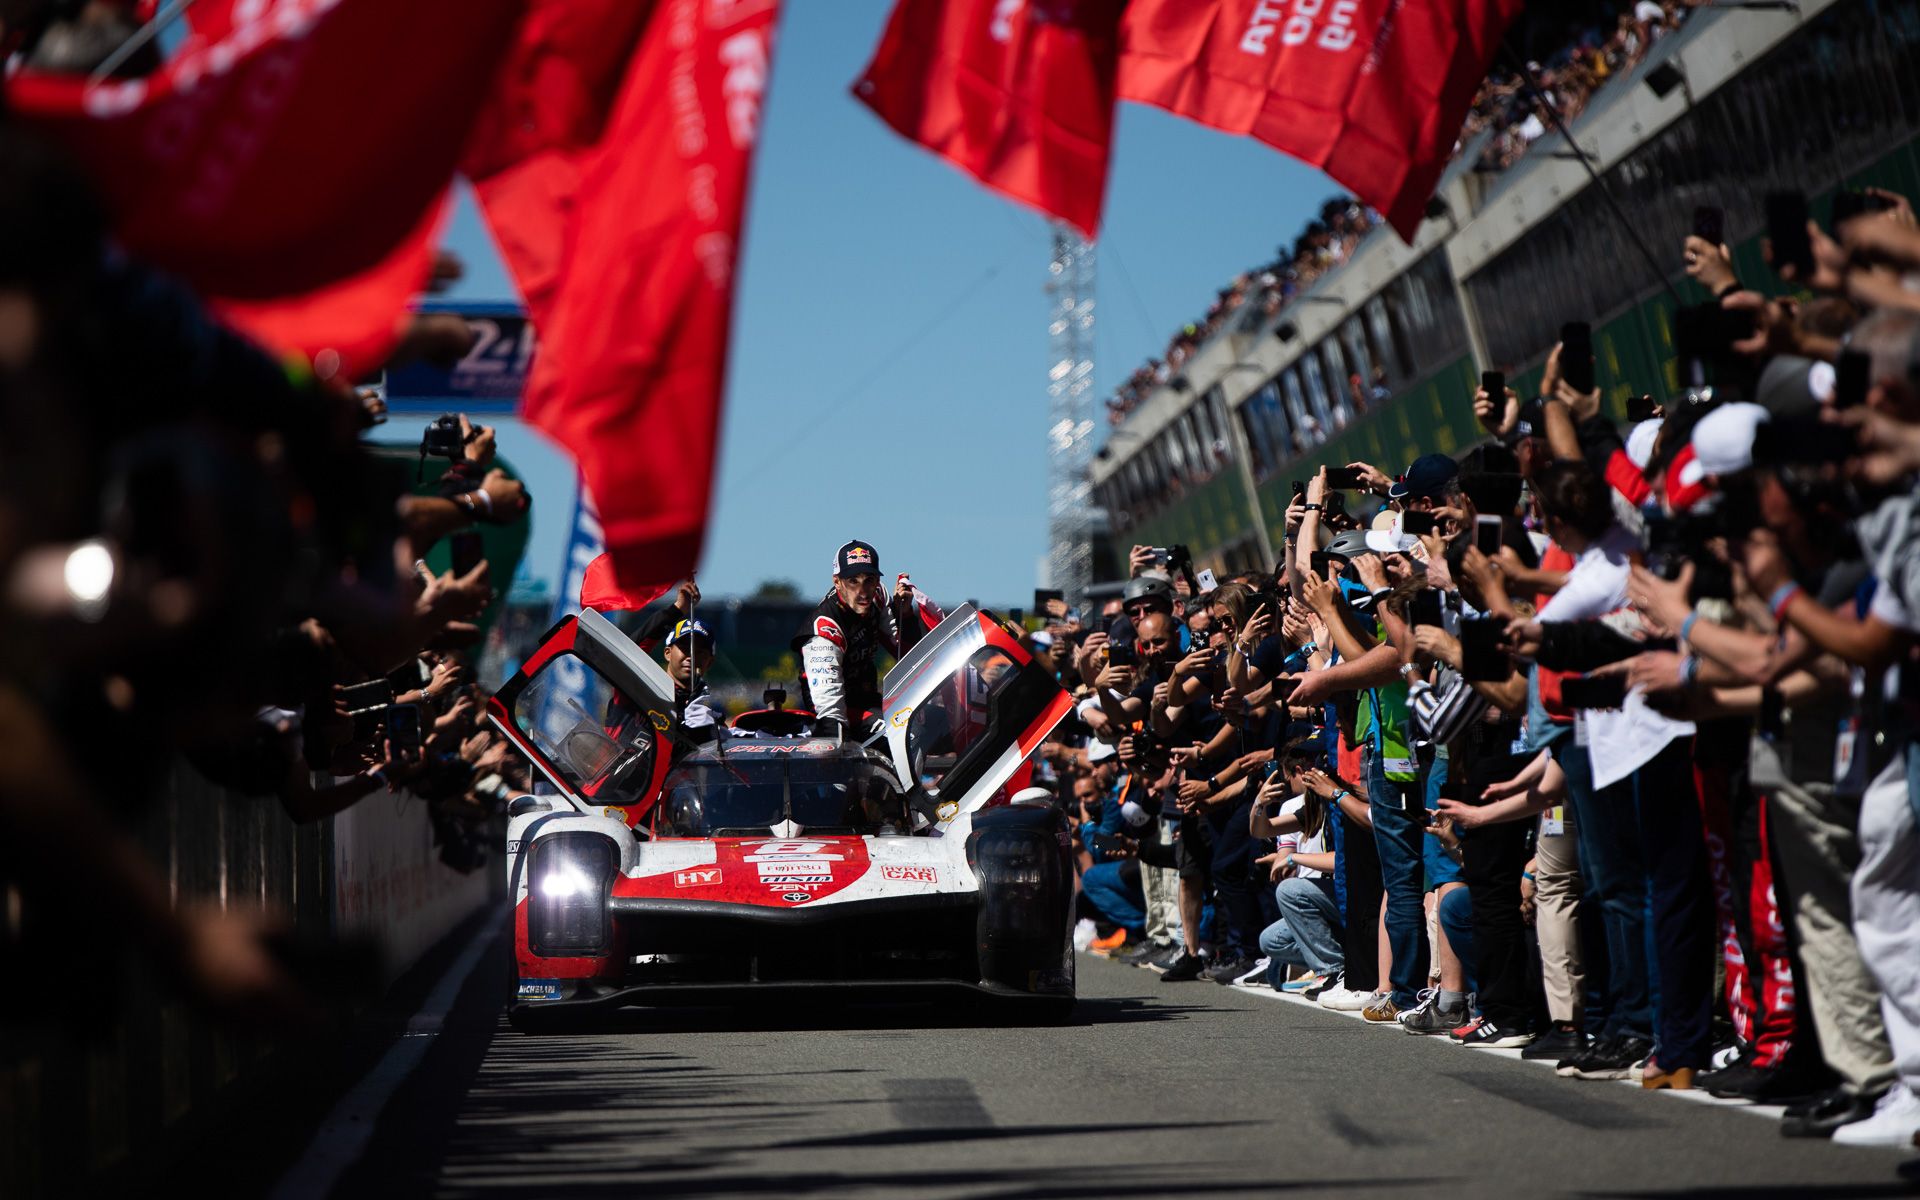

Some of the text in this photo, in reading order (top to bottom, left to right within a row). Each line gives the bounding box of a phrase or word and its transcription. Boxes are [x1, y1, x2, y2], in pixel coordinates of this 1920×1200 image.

[726, 745, 835, 753] DENSO
[766, 864, 821, 872] FUJITSU
[677, 870, 718, 884] HY
[886, 871, 932, 881] CAR
[769, 884, 822, 892] ZENT
